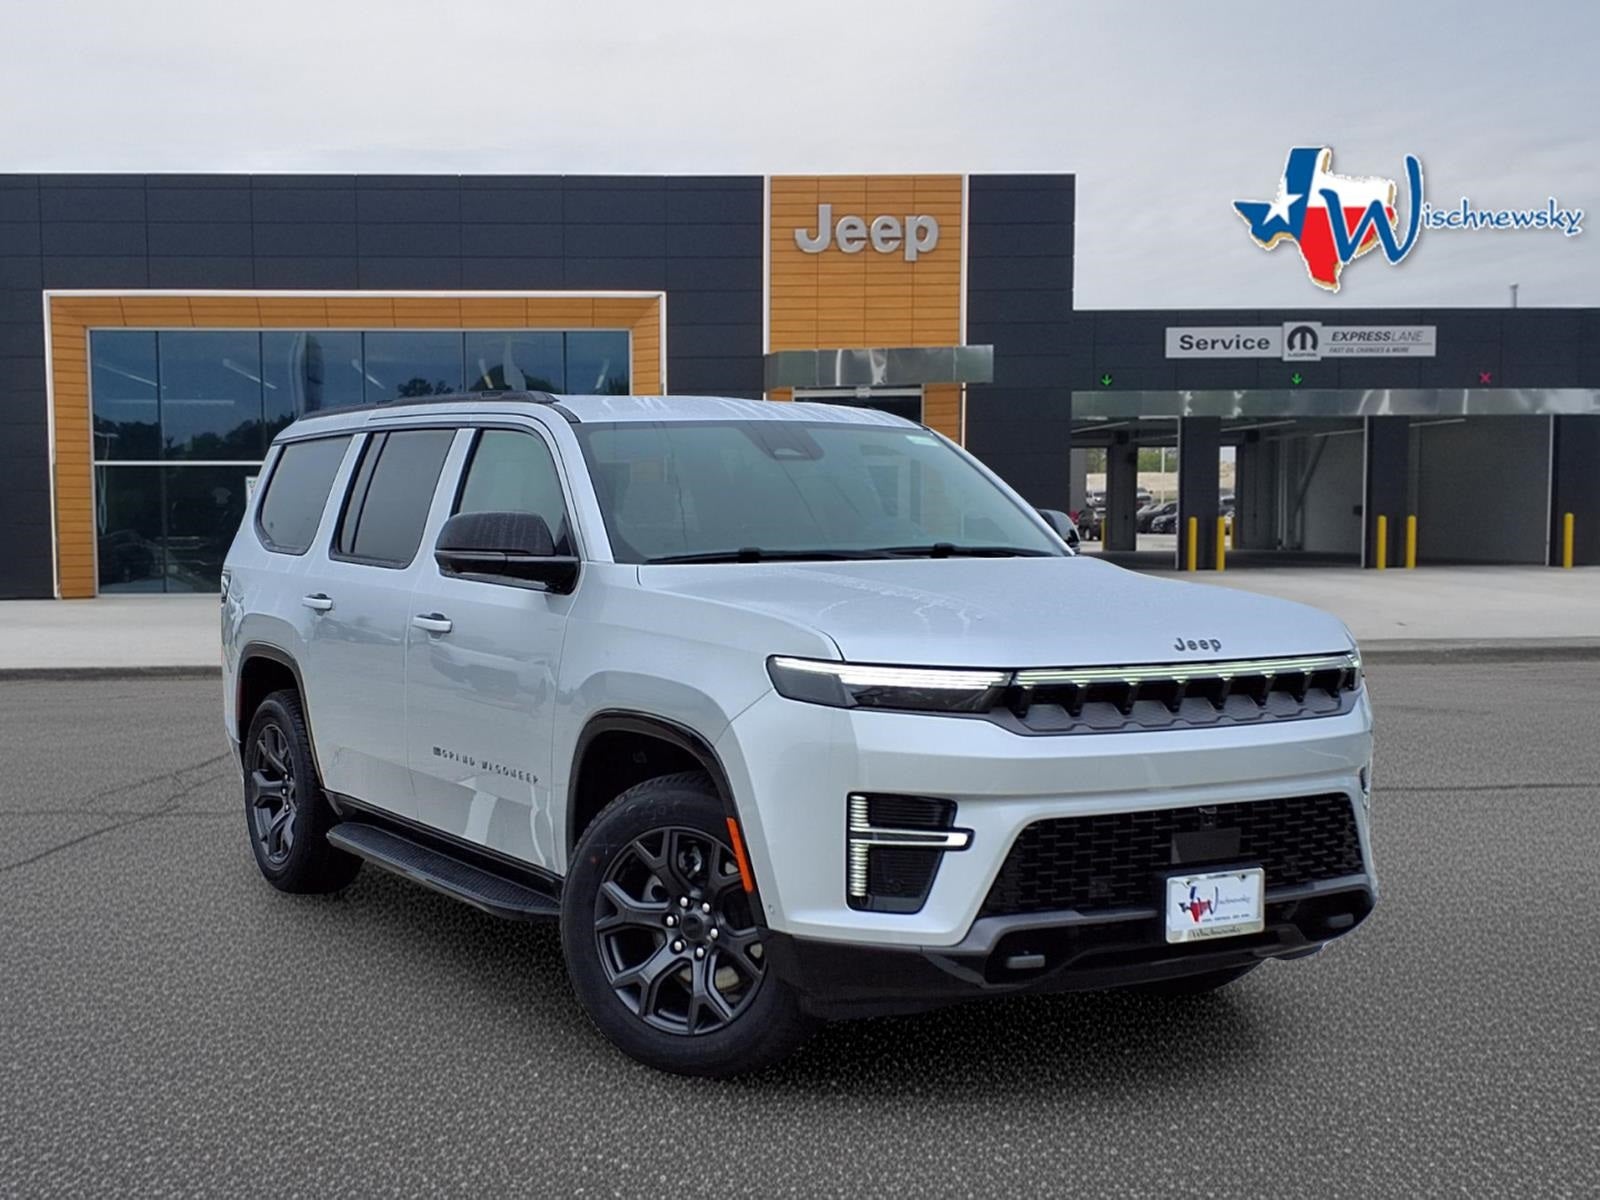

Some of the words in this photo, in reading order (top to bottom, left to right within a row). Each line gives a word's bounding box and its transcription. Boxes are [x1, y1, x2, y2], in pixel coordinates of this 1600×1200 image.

[794, 203, 939, 262] Jeep
[1178, 334, 1271, 351] Service
[1174, 637, 1222, 652] Jeep
